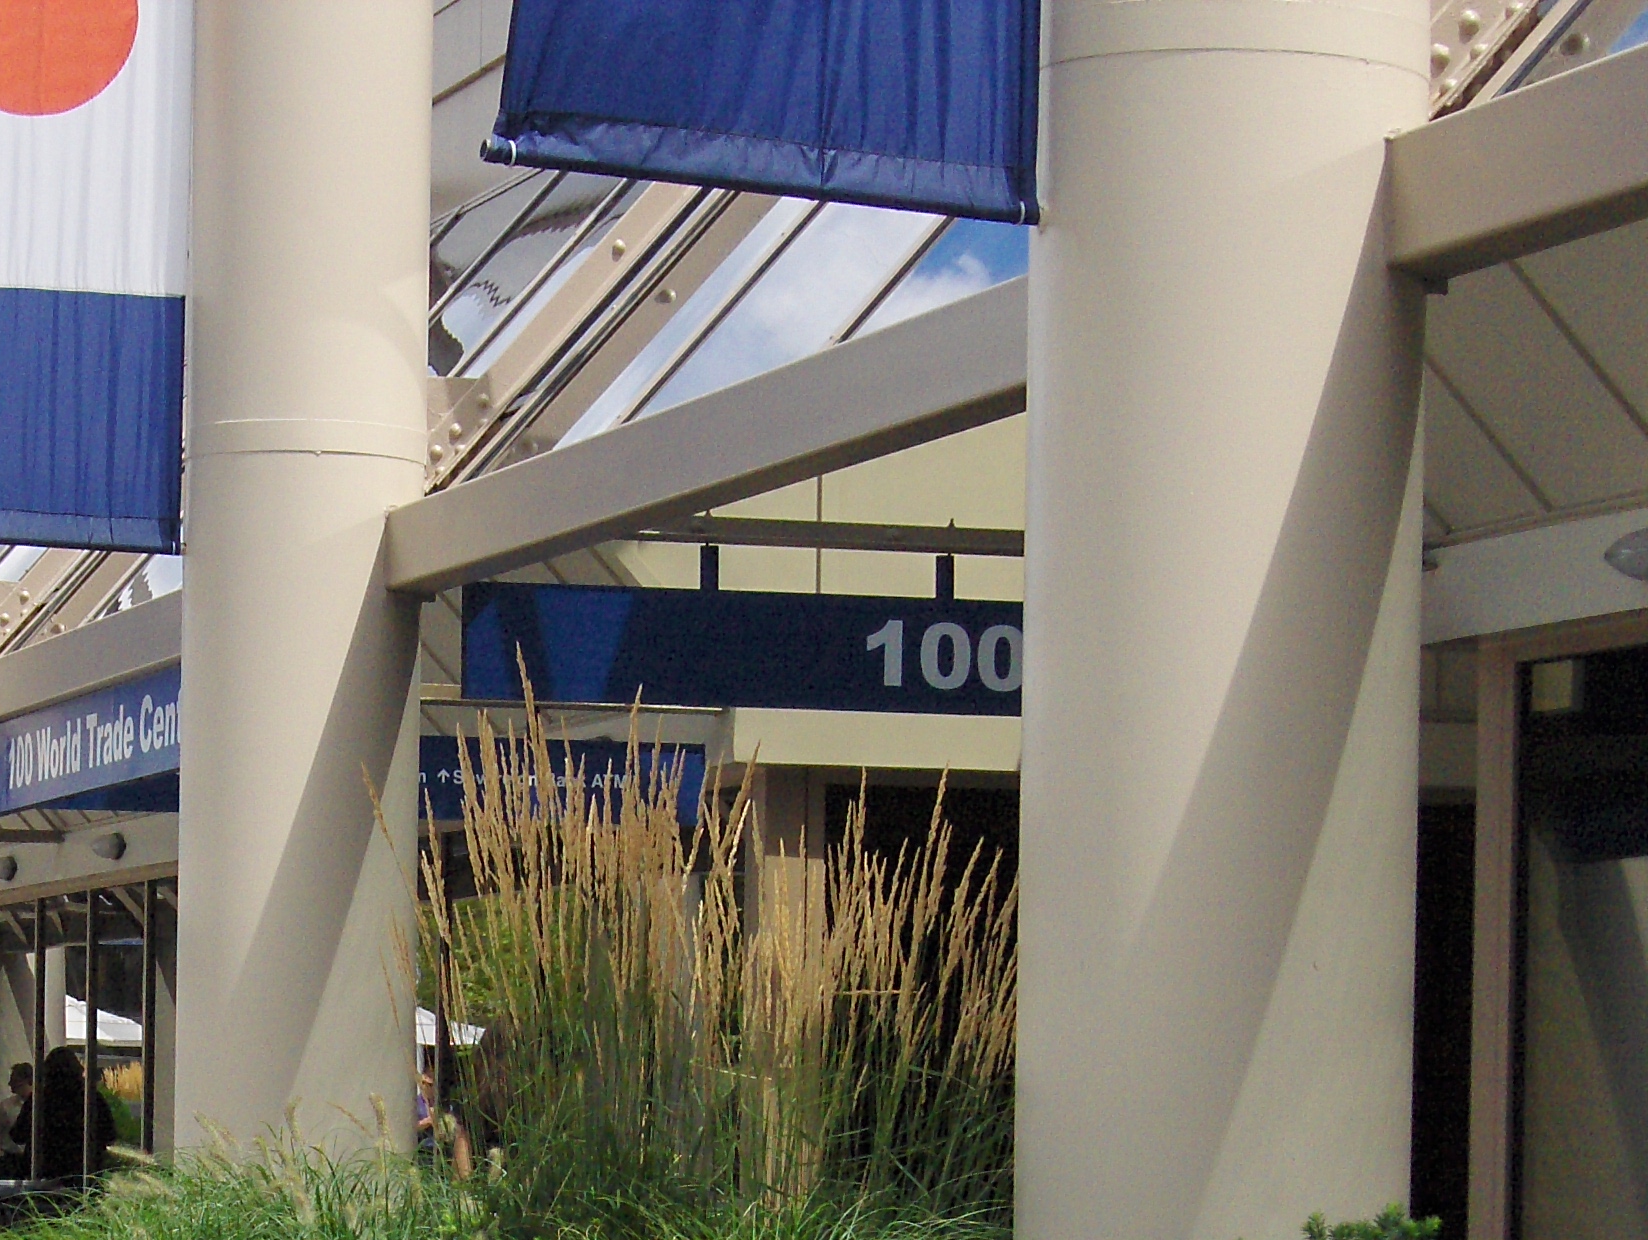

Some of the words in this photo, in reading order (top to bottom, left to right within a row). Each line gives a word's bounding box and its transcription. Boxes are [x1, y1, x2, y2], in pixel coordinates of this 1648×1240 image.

[866, 619, 1023, 692] 100
[9, 733, 33, 789] 100
[36, 717, 81, 782] World
[85, 704, 135, 769] Trade
